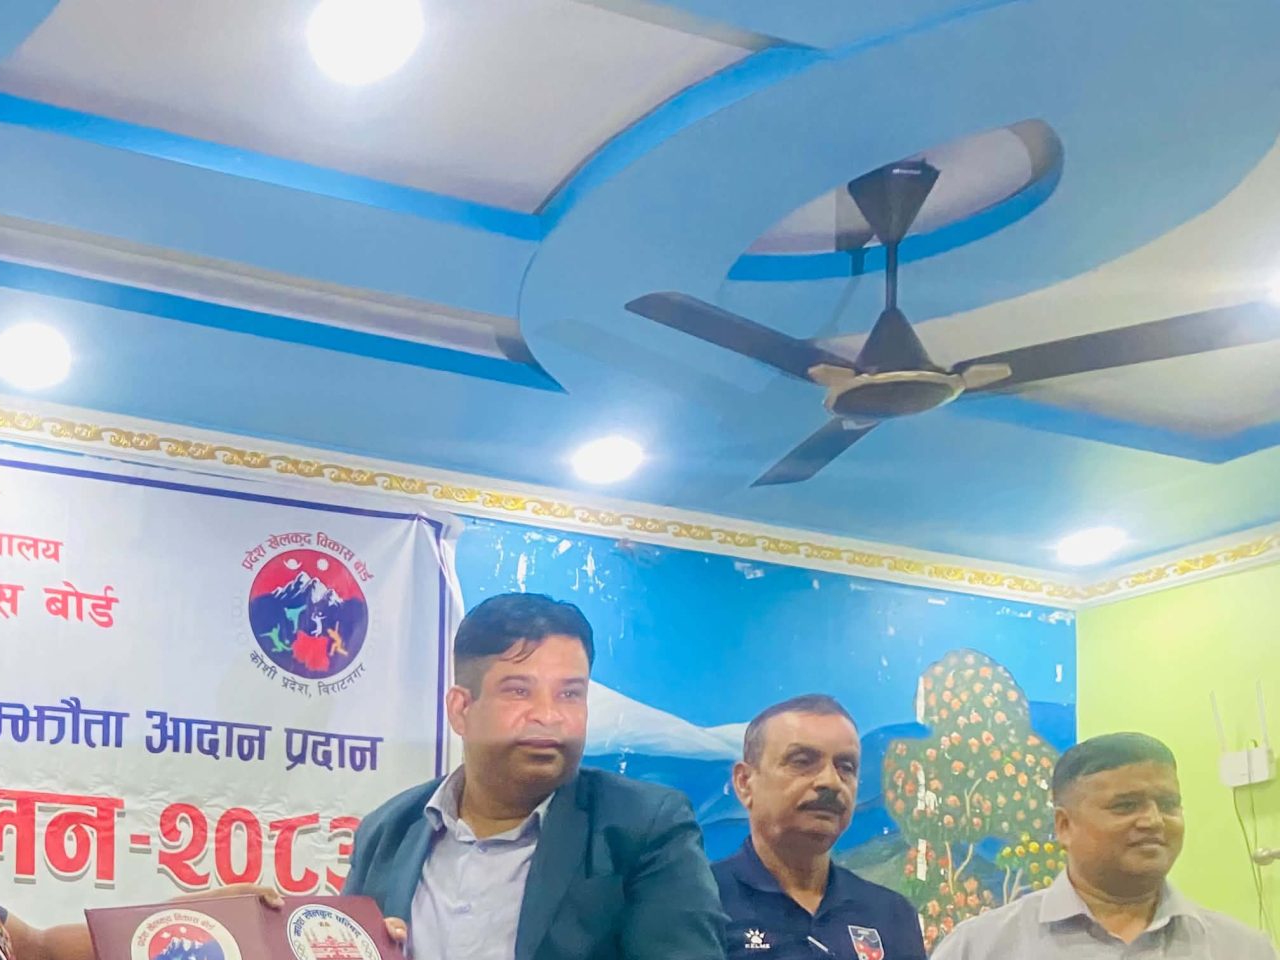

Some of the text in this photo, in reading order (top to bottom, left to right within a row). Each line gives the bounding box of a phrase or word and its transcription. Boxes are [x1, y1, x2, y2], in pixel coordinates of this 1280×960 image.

[44, 581, 119, 628] बोर्ड
[146, 710, 272, 761] आदान
[285, 728, 383, 772] प्रदान
